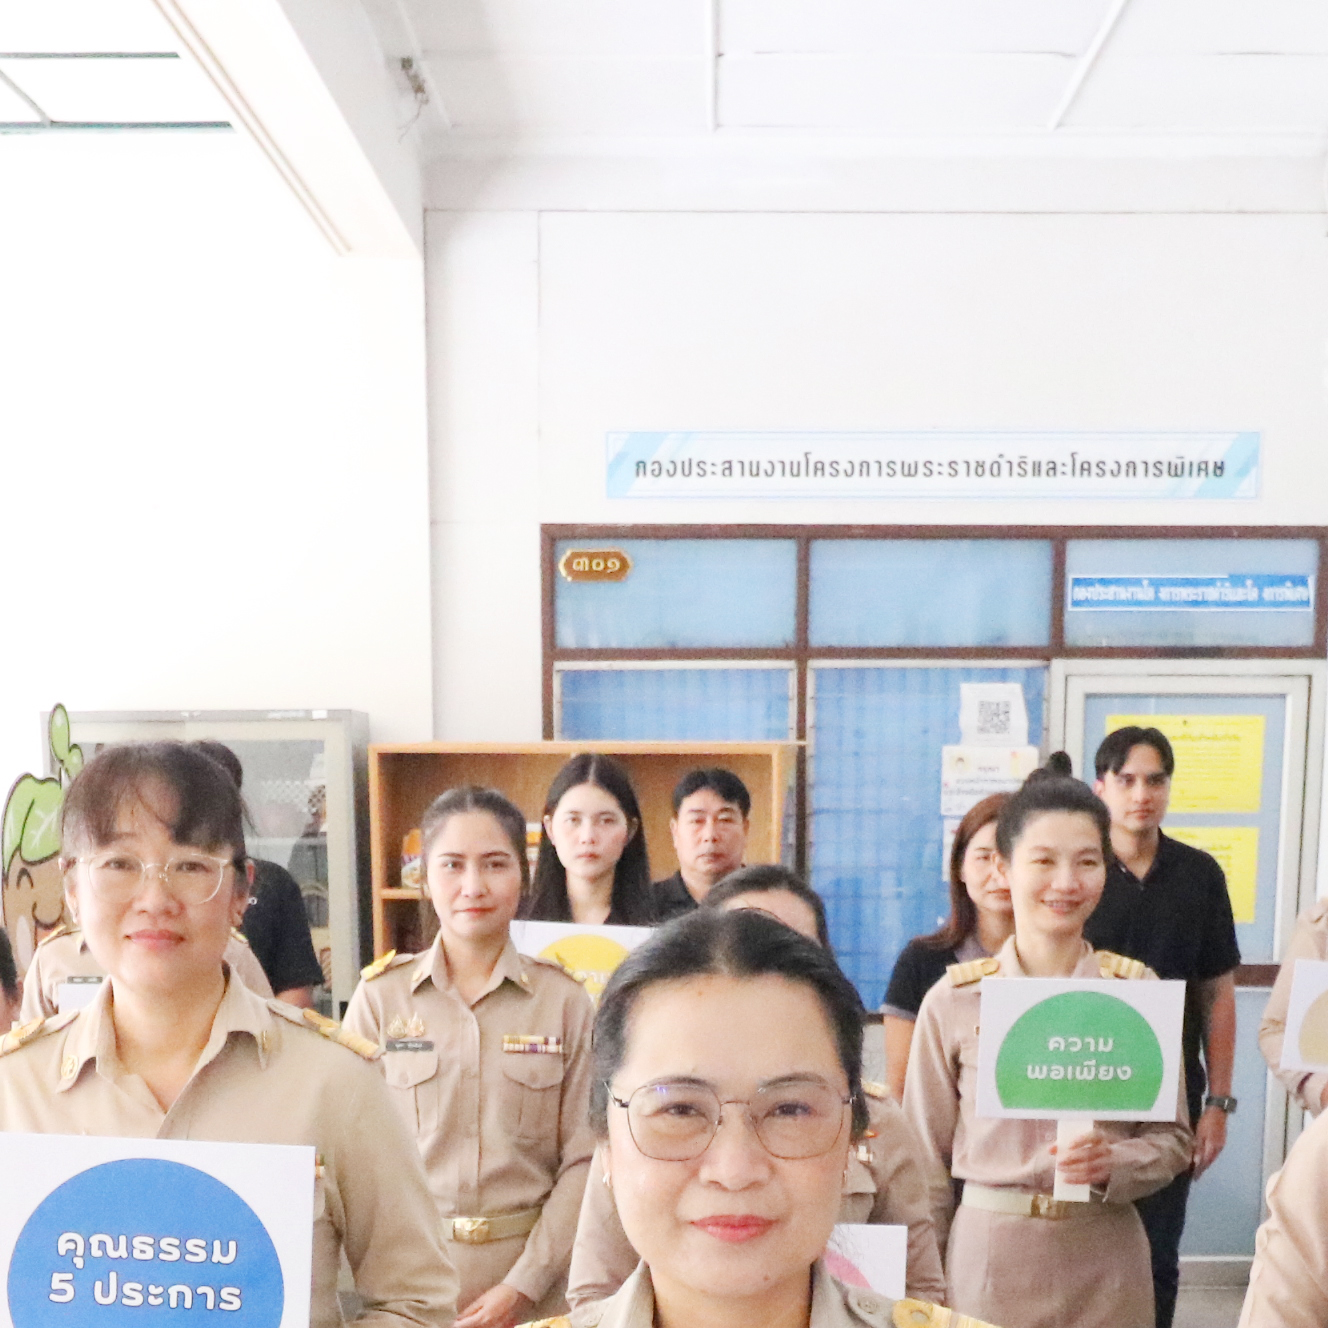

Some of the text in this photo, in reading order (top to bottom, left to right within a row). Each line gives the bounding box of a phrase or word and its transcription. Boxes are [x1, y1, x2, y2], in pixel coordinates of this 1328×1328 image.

[634, 451, 1227, 479] กองประสานงานโครงการพระราชดำริและโครงการพิเศษ
[572, 556, 621, 574] ๓๐๑
[1047, 1035, 1114, 1053] ความ
[1026, 1059, 1133, 1081] พอเพียง
[56, 1231, 238, 1269] คุณธรรม
[48, 1270, 242, 1312] 5 ประการ
